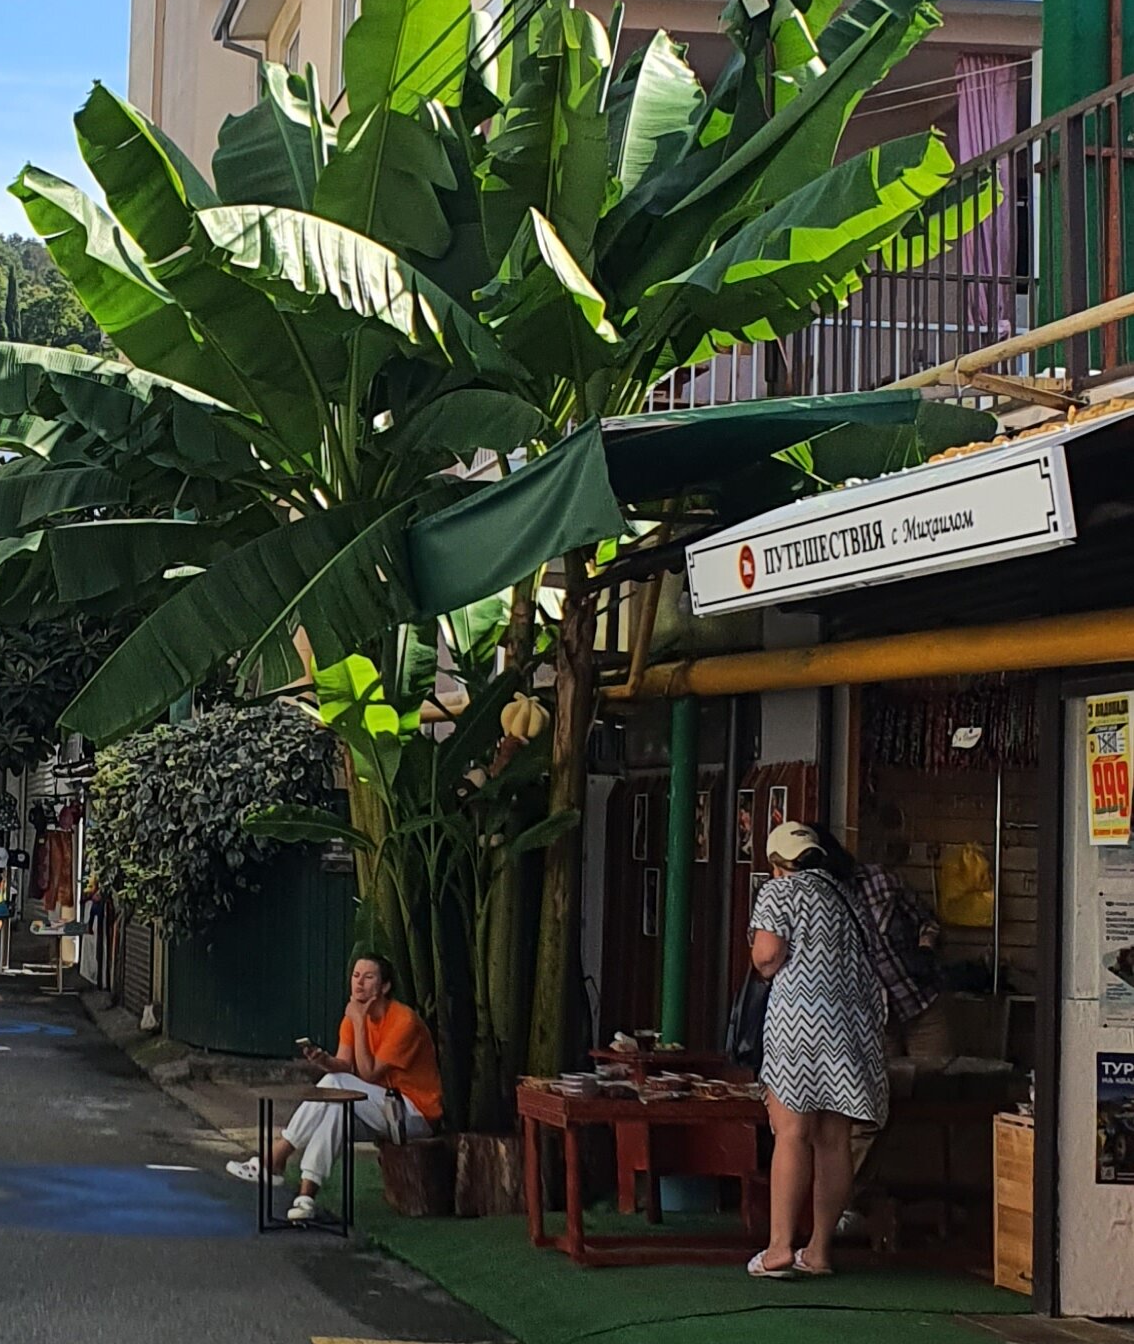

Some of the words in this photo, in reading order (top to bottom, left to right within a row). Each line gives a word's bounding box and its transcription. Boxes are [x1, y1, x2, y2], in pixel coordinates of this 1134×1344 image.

[763, 519, 886, 575] ПУТЕШЕСТВИЯ
[891, 527, 898, 545] с
[902, 508, 974, 543] Михаилом
[1092, 760, 1129, 817] 999
